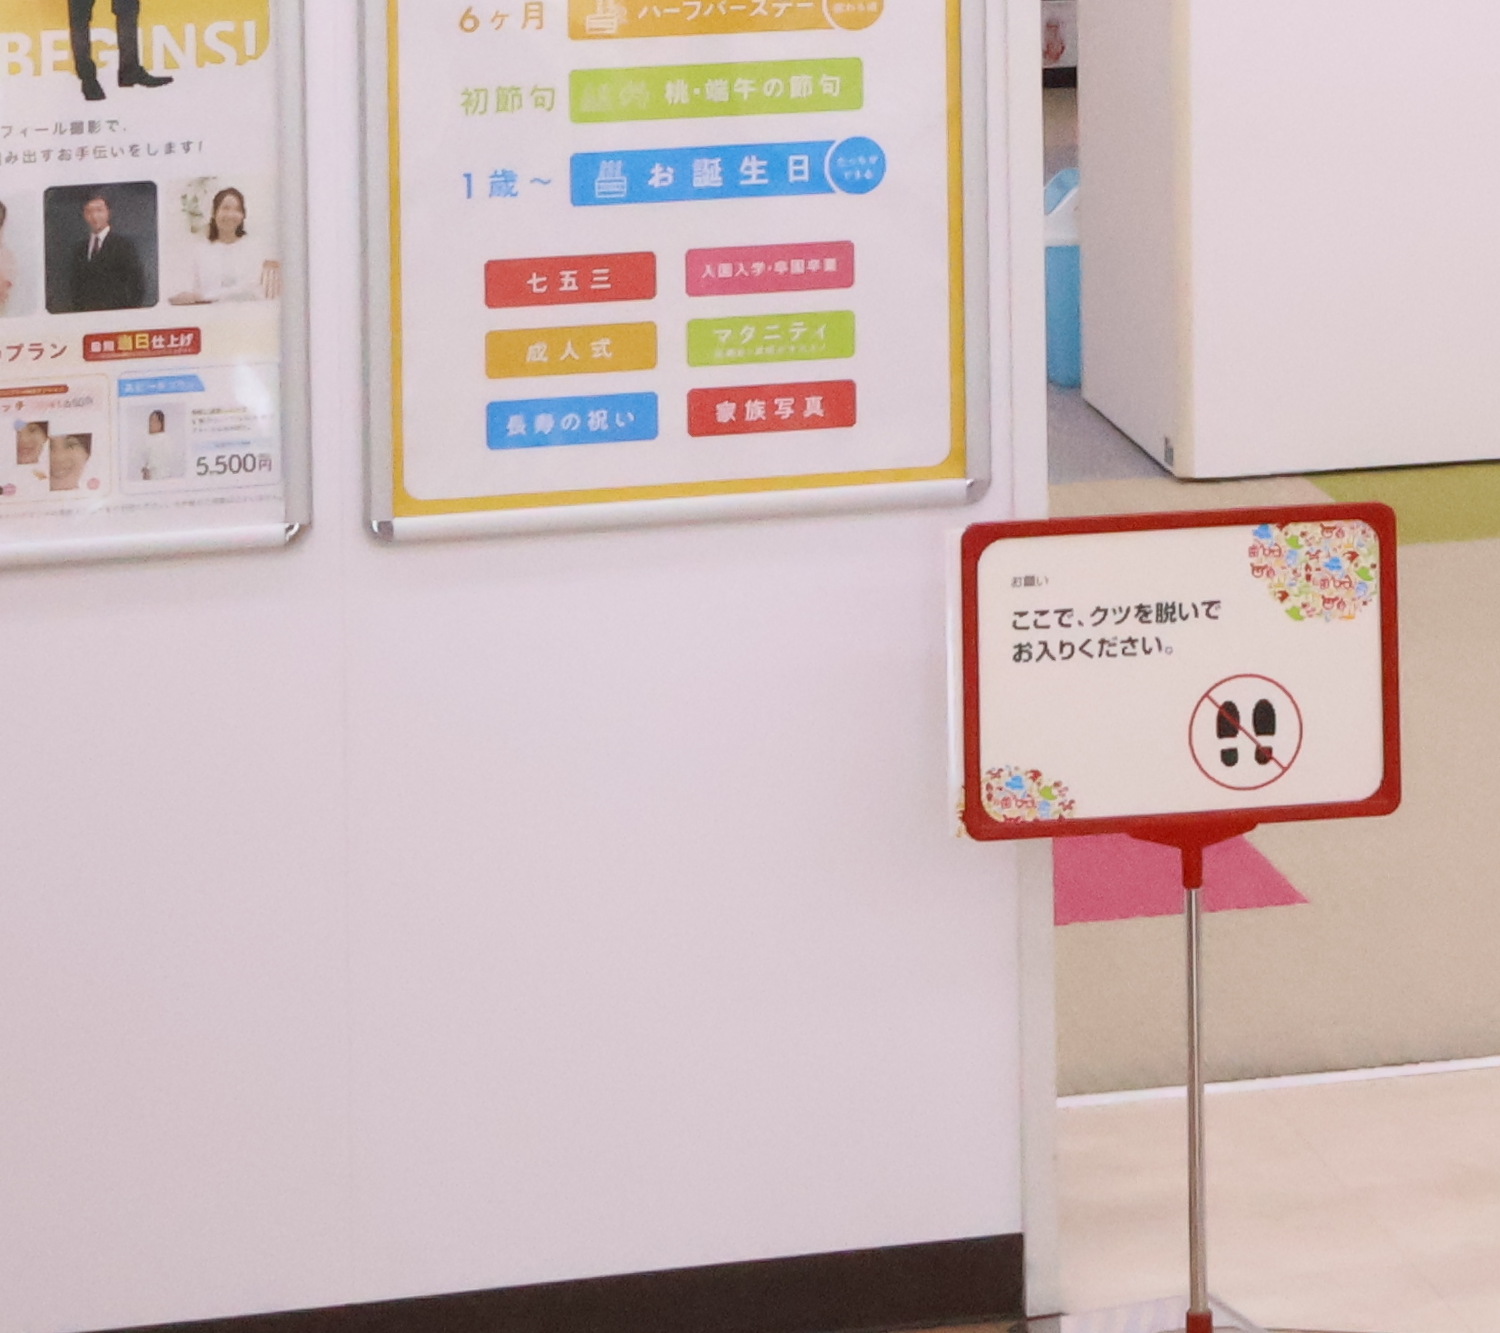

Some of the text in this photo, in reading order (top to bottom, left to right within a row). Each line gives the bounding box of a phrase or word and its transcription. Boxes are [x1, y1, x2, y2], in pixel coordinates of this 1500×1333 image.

[459, 84, 557, 116] 初節句
[647, 154, 811, 189] お誕生日
[526, 268, 612, 294] 七五三
[525, 320, 828, 363] 成人式 マタニティ
[715, 395, 825, 424] 家族写真
[1011, 599, 1222, 631] ここで、クツを脱いで
[1011, 636, 1174, 664] お入りください。
